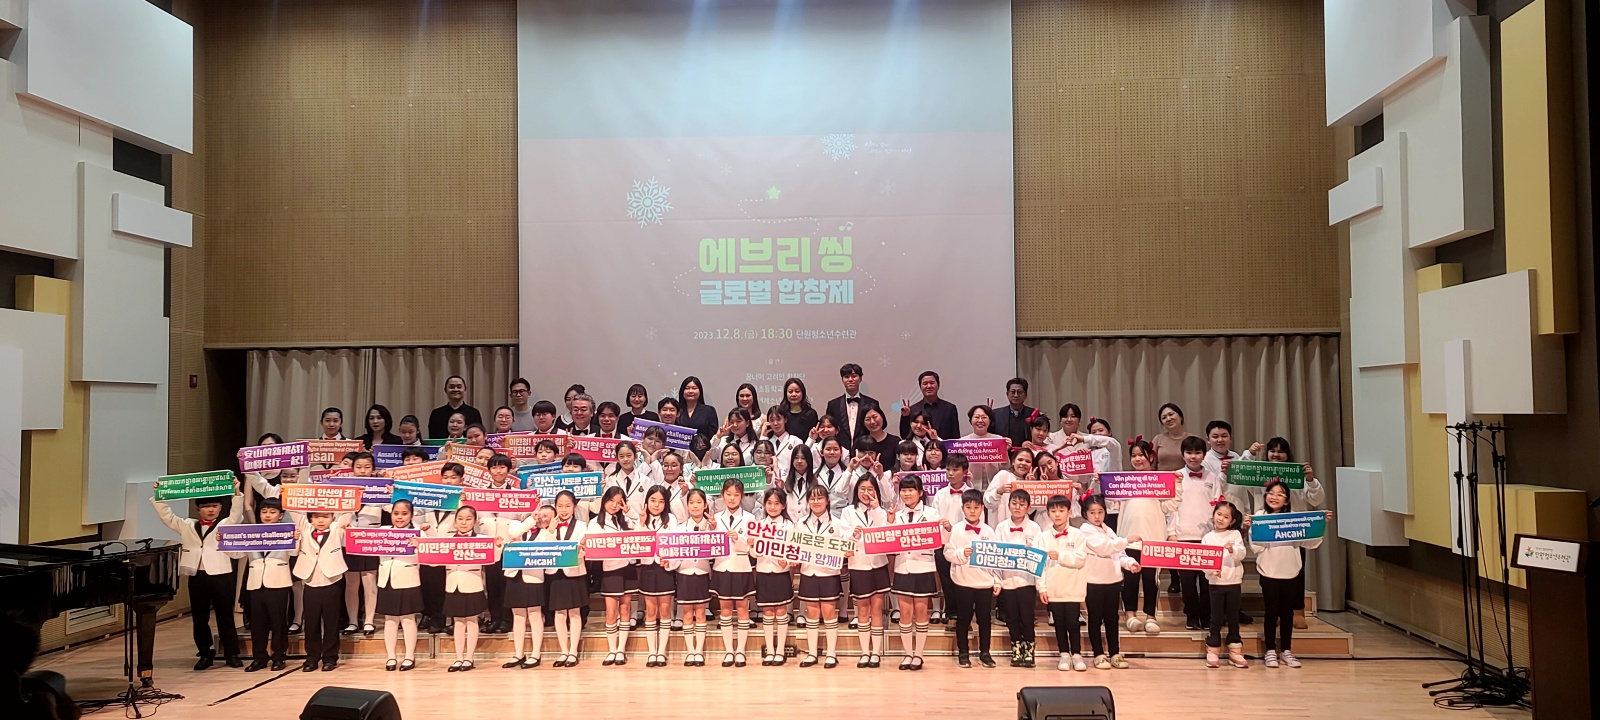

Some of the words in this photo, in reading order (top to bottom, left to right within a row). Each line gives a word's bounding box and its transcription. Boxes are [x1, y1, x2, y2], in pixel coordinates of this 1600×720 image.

[699, 237, 811, 273] 에브리
[818, 236, 853, 273] 씽
[700, 280, 772, 305] 글로벌
[778, 278, 854, 305] 합창제
[760, 328, 793, 339] 18:30
[796, 330, 856, 340] 단원청소년수련관
[310, 452, 334, 462] san
[534, 476, 560, 487] 안산의
[288, 488, 316, 496] 이민청!
[318, 488, 342, 498] 안산의
[344, 489, 356, 498] 길!
[1030, 494, 1048, 504] san
[286, 497, 339, 509] 대한민국의
[342, 498, 356, 509] 길!
[412, 496, 442, 506] Ансан!
[498, 498, 530, 508] 안산으로
[261, 531, 294, 539] challenge!
[747, 521, 787, 540] 안산의
[790, 532, 825, 548] 새로운
[865, 530, 901, 544] 이민청은
[902, 526, 939, 536] 상호문화도시
[1274, 528, 1306, 539] Ансан!
[586, 536, 622, 548] 이민청은
[620, 543, 652, 554] 안산으로
[900, 535, 934, 548] 안산으로
[418, 542, 456, 554] 이민청은
[453, 550, 487, 560] 안산으로
[755, 540, 812, 562] 이민청과
[815, 552, 842, 568] 함께!
[976, 542, 1003, 556] 안산의
[1004, 548, 1026, 557] 새로운
[1142, 545, 1182, 558] 이민청은
[1183, 547, 1222, 557] 상호문화도시
[524, 556, 556, 566] Ансан!
[976, 554, 1015, 568] 이민청과
[1179, 554, 1214, 566] 안산으로
